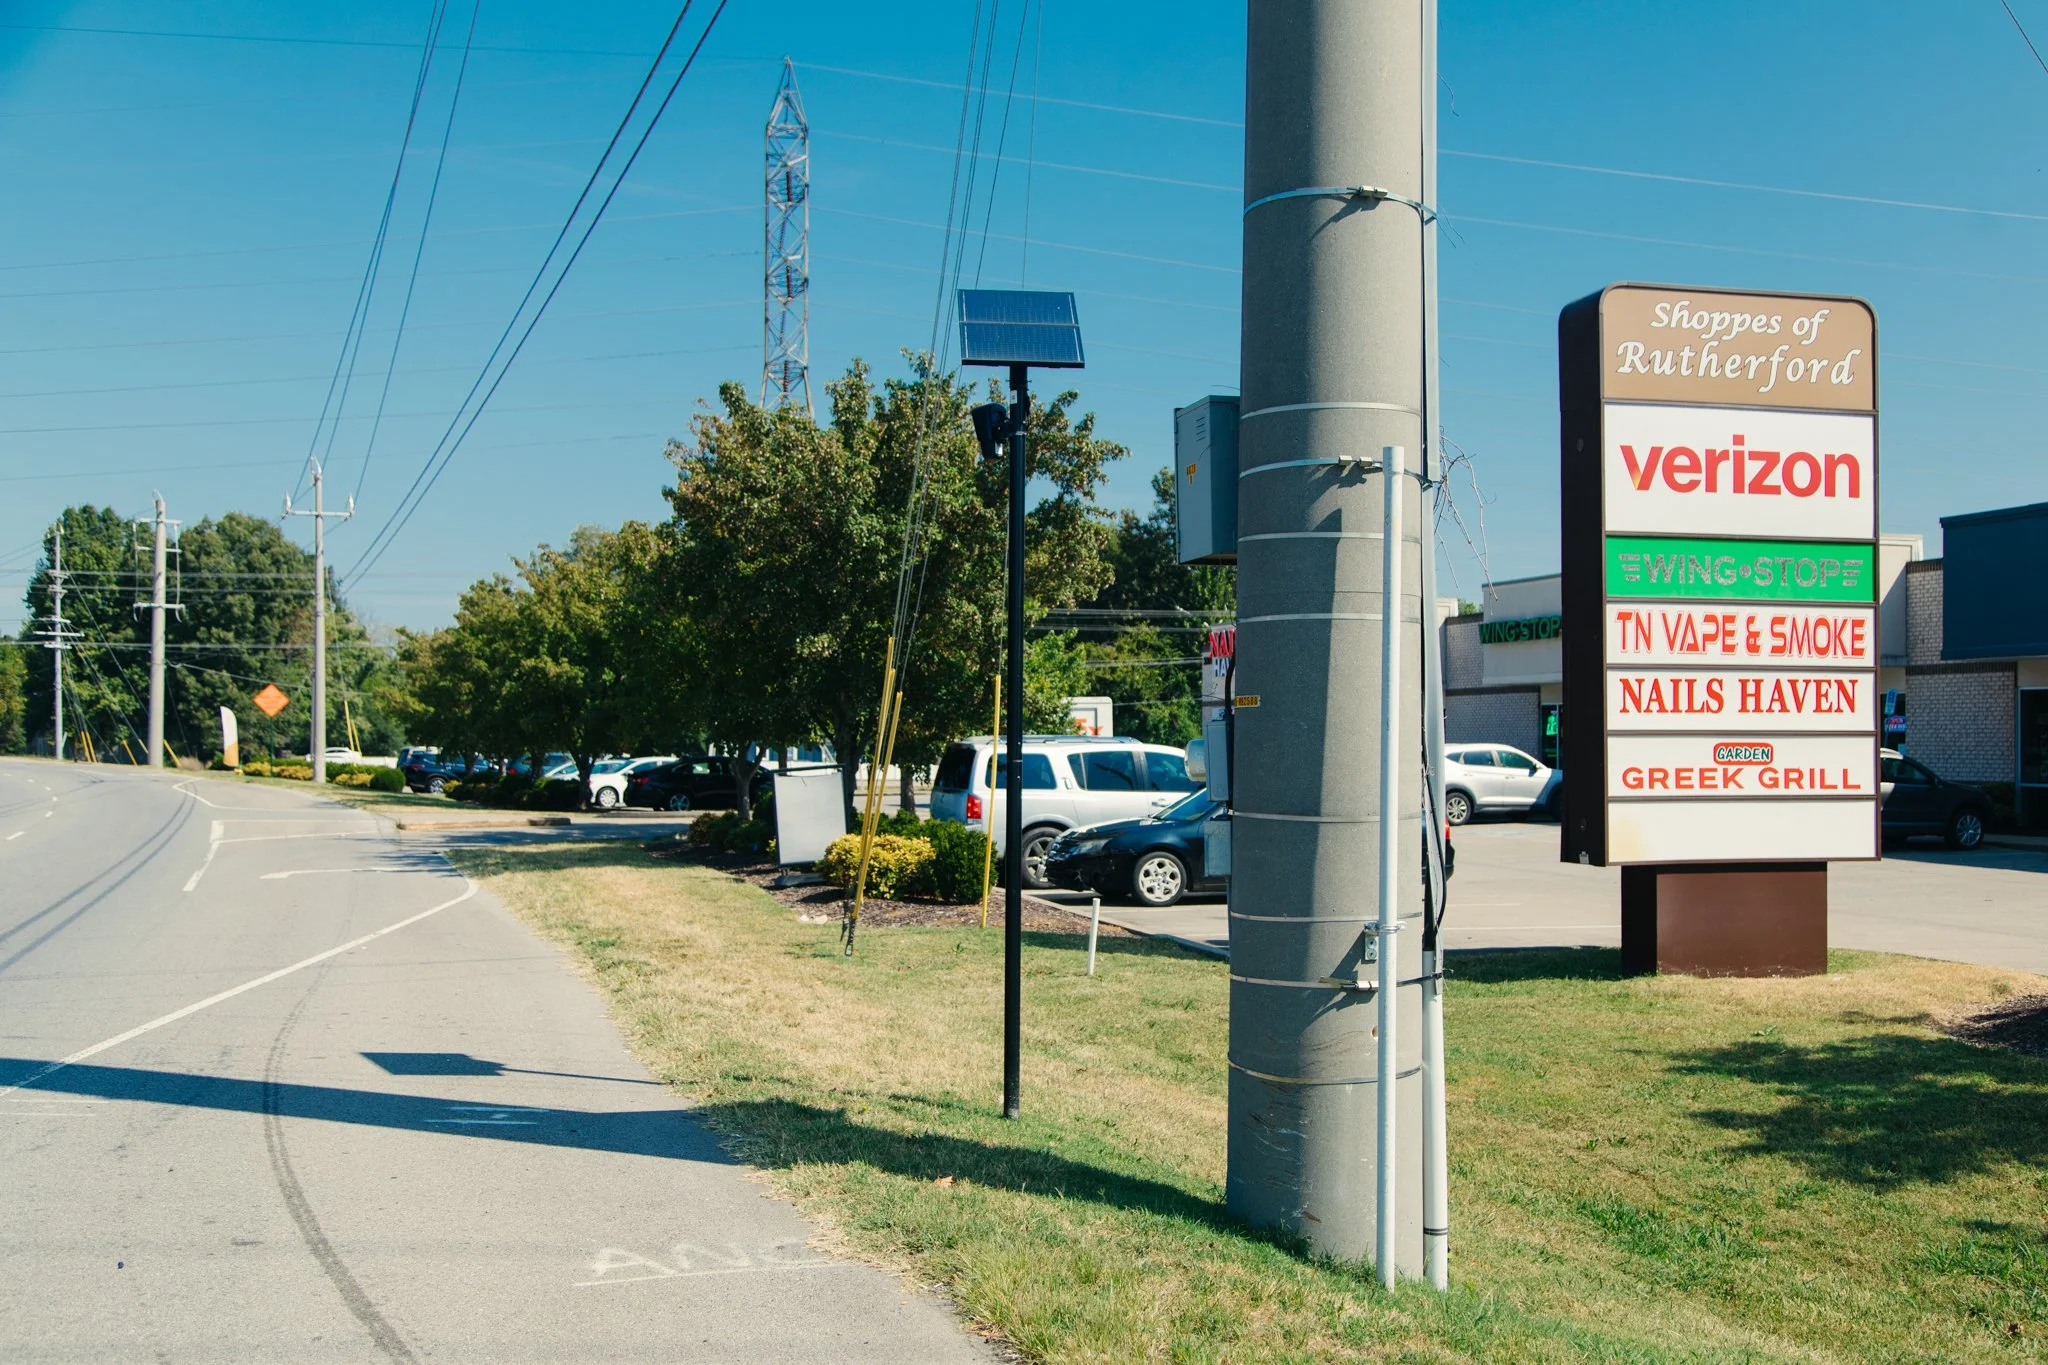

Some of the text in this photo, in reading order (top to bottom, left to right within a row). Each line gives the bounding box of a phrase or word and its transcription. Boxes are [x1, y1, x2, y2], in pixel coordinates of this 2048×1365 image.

[1650, 299, 1831, 346] Shoppes of
[1615, 340, 1863, 393] Rutherford
[1619, 434, 1861, 499] verizon
[1615, 610, 1868, 659] TN VAPE & SMOKE
[1618, 677, 1725, 715] NAILS
[1737, 677, 1859, 715] HAVEN
[1716, 746, 1772, 762] GARDEN
[1621, 766, 1862, 790] GREEK GRILL
